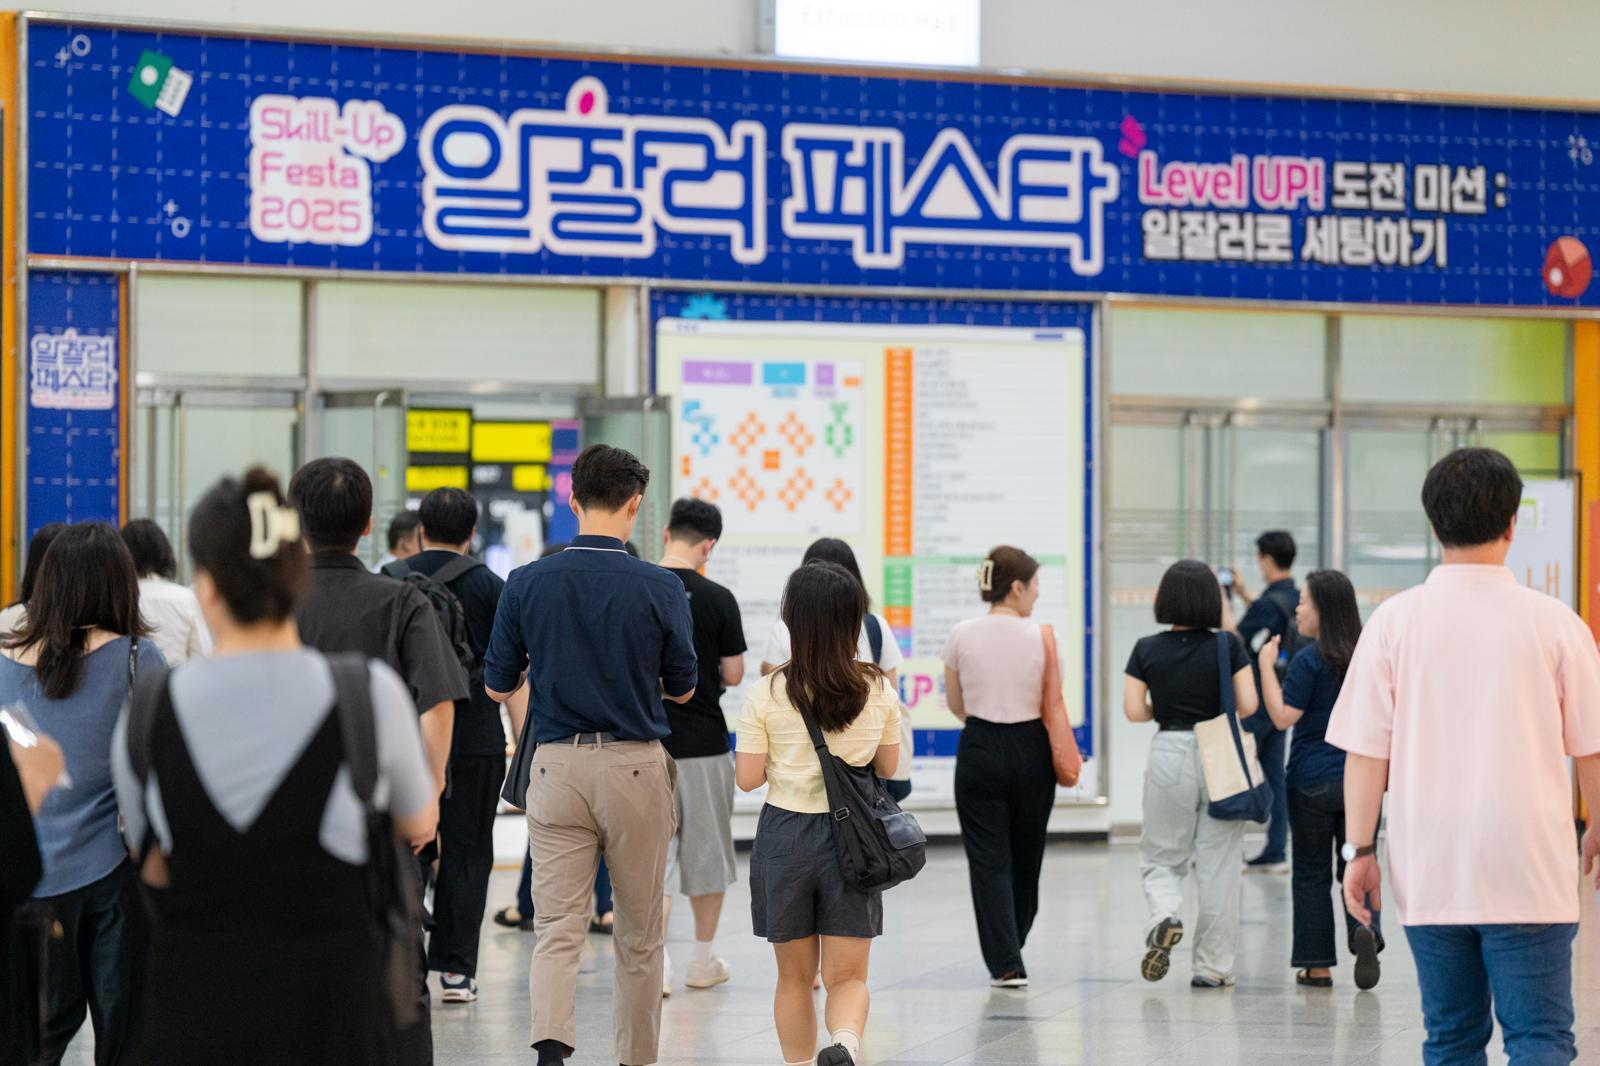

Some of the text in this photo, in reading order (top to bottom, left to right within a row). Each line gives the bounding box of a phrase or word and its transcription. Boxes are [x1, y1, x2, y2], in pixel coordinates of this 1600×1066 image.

[260, 106, 396, 147] Skill-Up
[260, 151, 360, 188] Festa
[419, 77, 1119, 275] 일잘러 페스타
[1142, 154, 1247, 206] Level
[1255, 157, 1324, 208] UP!
[1332, 161, 1405, 211] 도전
[1414, 164, 1487, 214] 미션
[260, 196, 362, 233] 2025
[1142, 209, 1447, 268] 일잘러로 세팅하기
